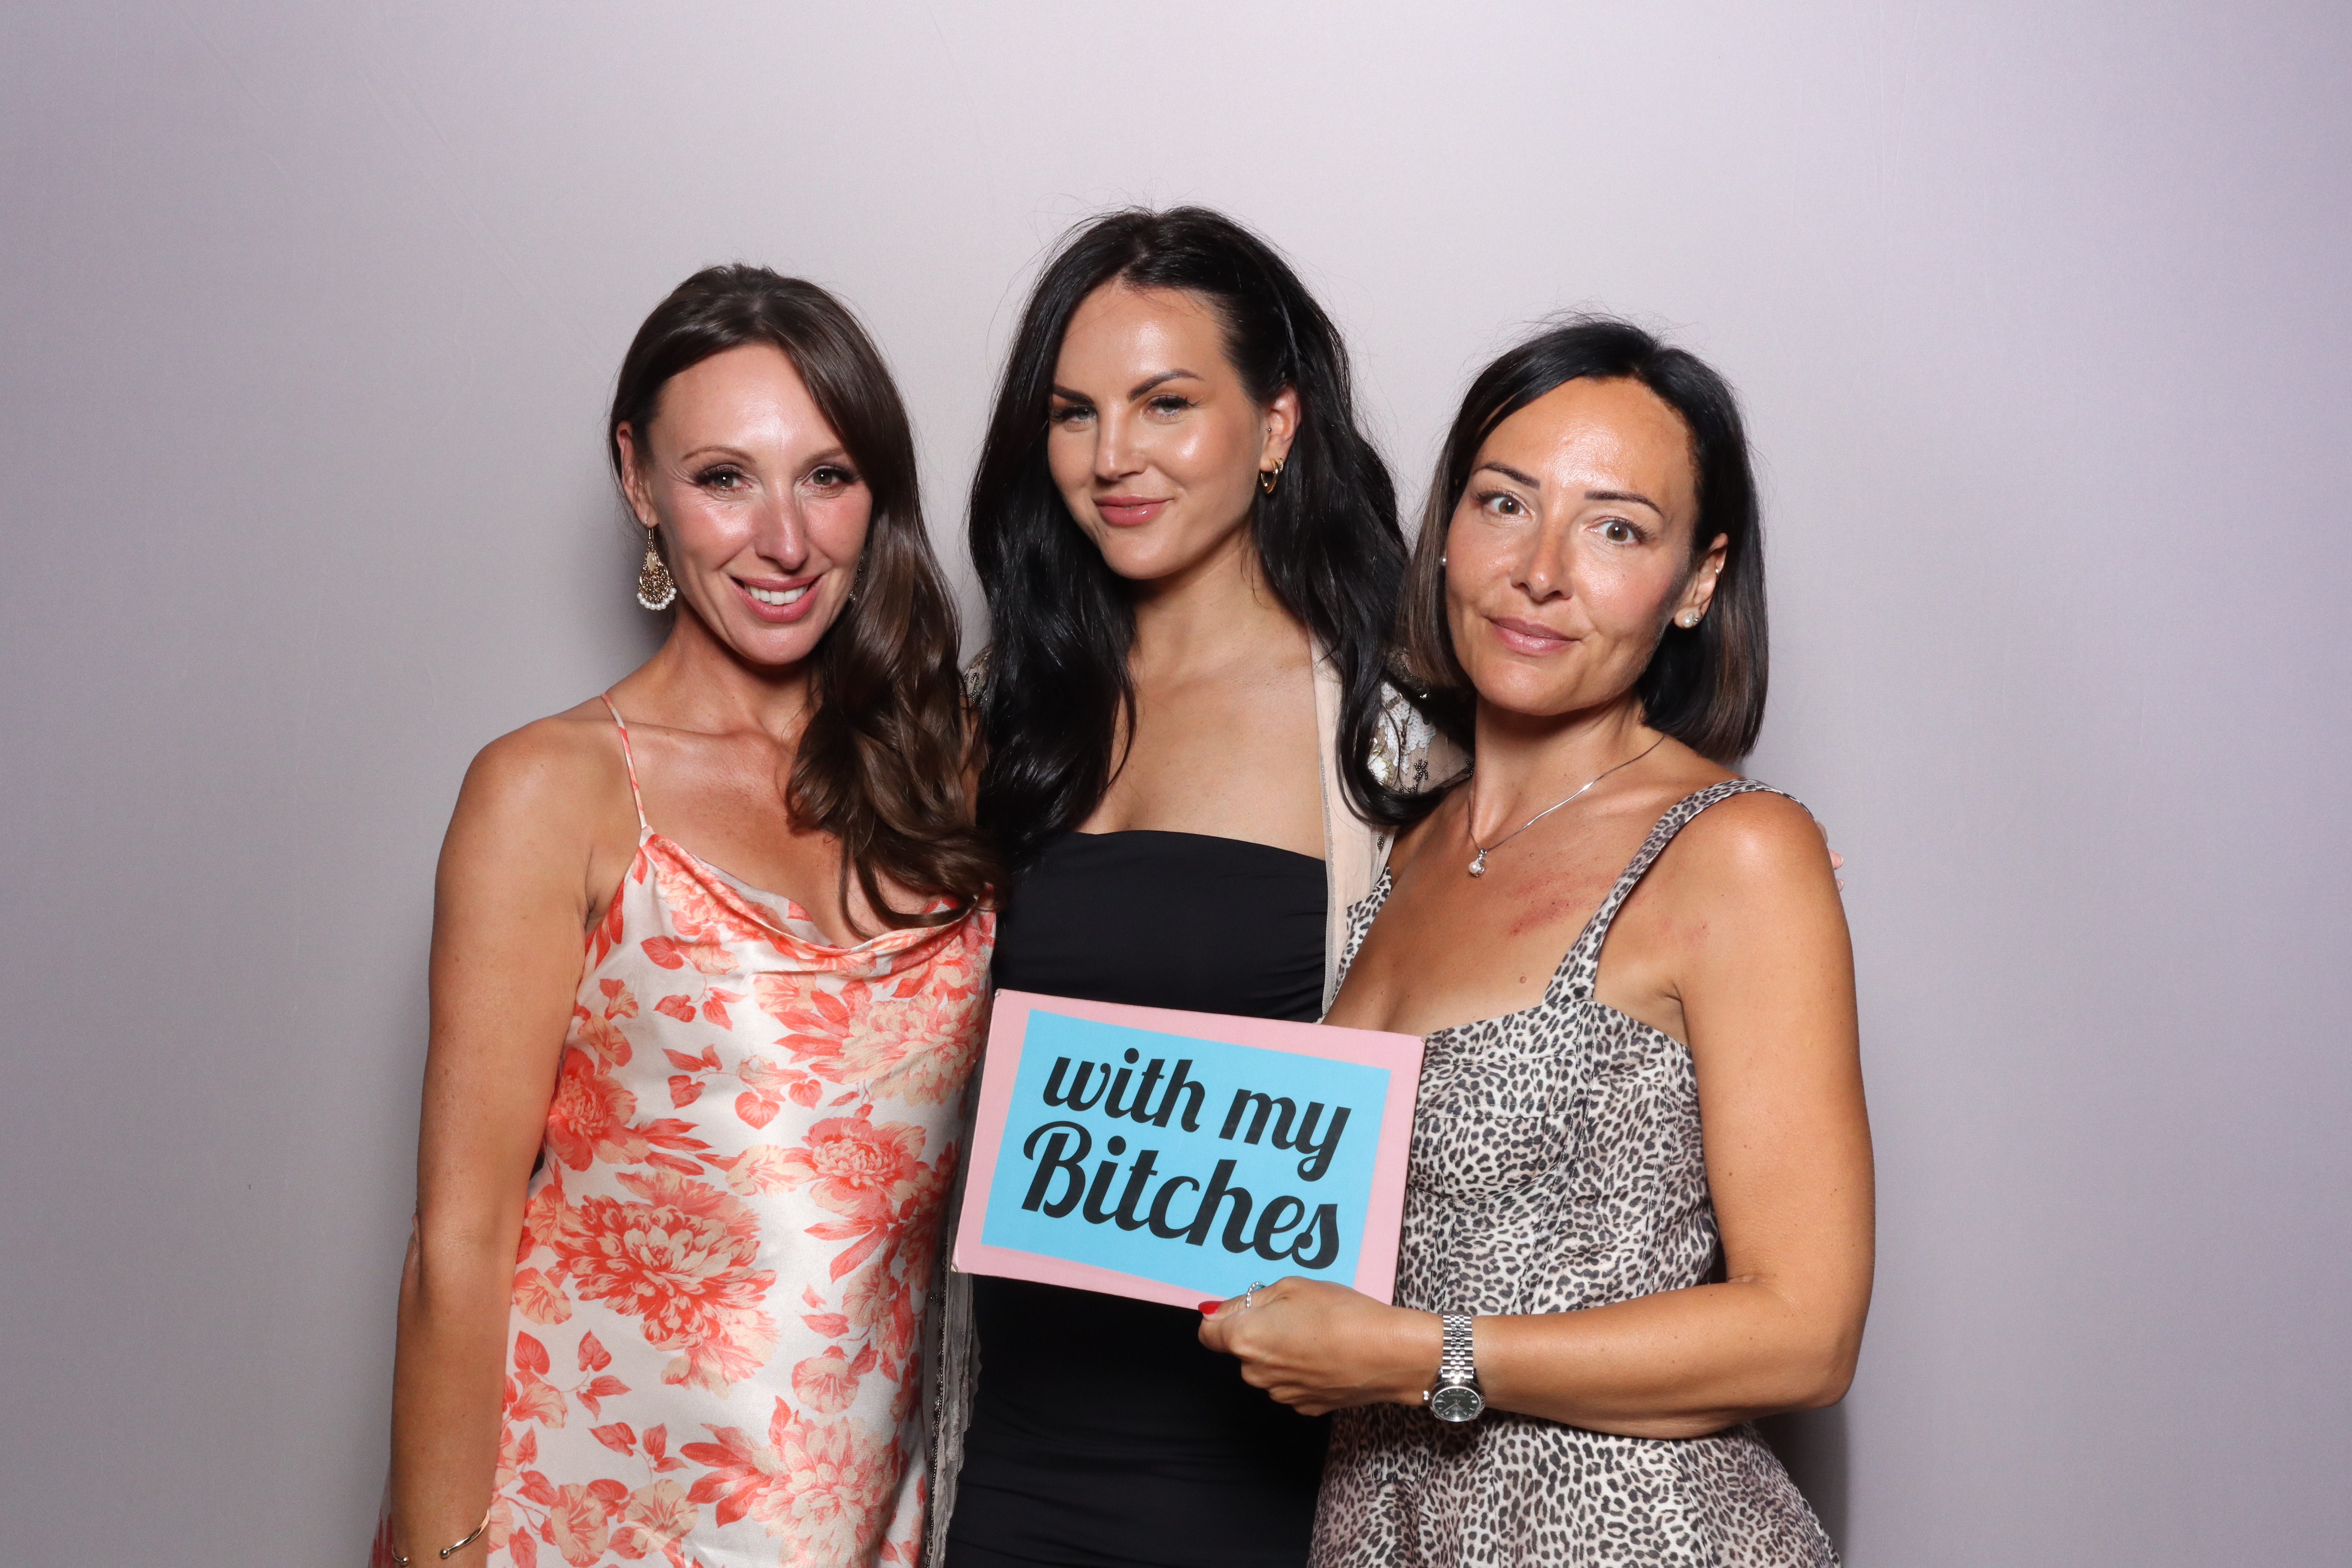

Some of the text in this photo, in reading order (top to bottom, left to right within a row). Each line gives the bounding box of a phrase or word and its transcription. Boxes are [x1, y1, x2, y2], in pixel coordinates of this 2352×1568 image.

[1043, 1047, 1352, 1182] with my
[1021, 1120, 1339, 1270] Bitches
